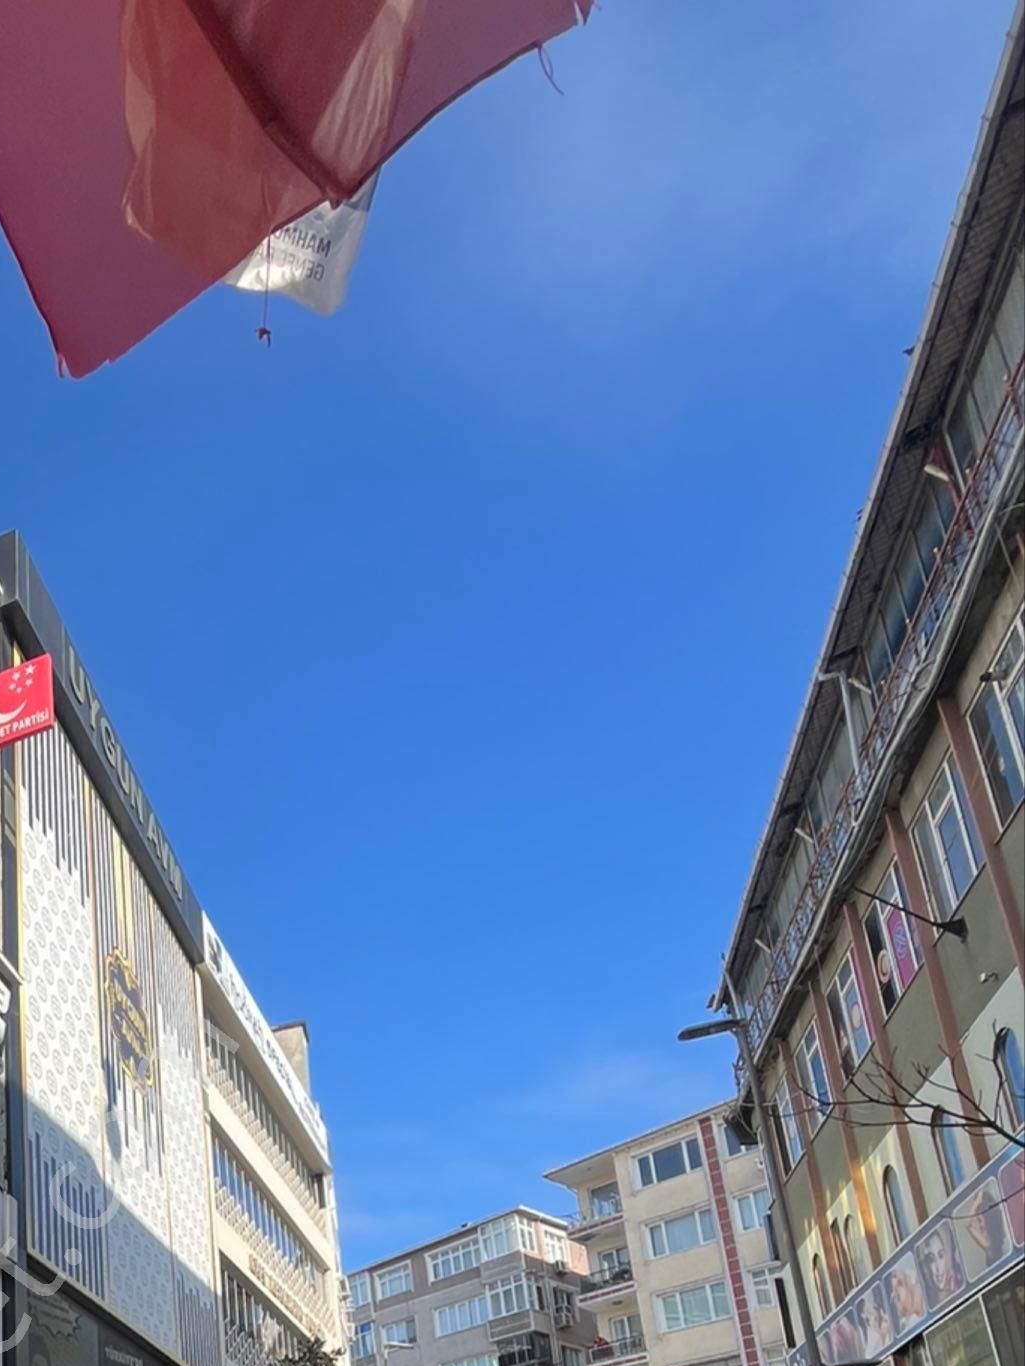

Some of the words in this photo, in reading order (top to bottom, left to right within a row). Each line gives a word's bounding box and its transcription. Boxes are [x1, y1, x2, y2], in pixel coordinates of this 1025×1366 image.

[12, 707, 50, 733] PARTİSİ
[69, 645, 146, 822] UYGUN
[145, 810, 184, 900] AVM
